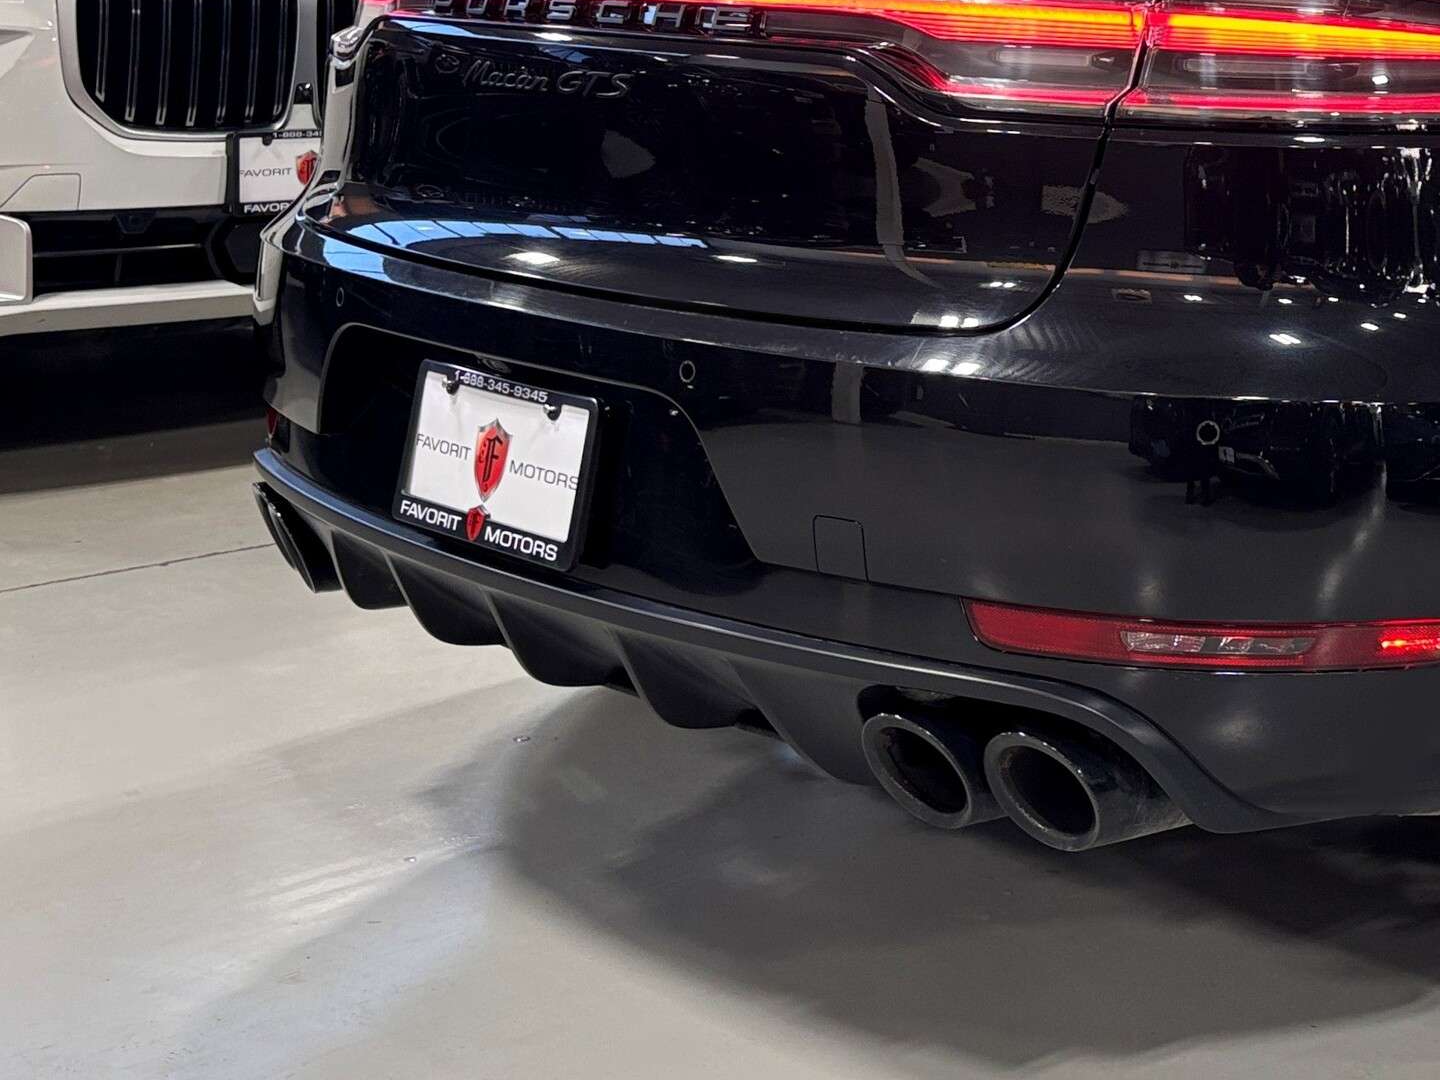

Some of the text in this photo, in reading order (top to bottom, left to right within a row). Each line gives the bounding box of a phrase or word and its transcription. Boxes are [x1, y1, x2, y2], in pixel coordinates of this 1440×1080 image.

[463, 58, 632, 98] Macan GTS
[454, 370, 548, 404] 1-888-345-9345
[415, 432, 472, 461] FAVORIT
[509, 459, 579, 491] MOTORS
[400, 499, 559, 562] FAVORIT MOTORS
